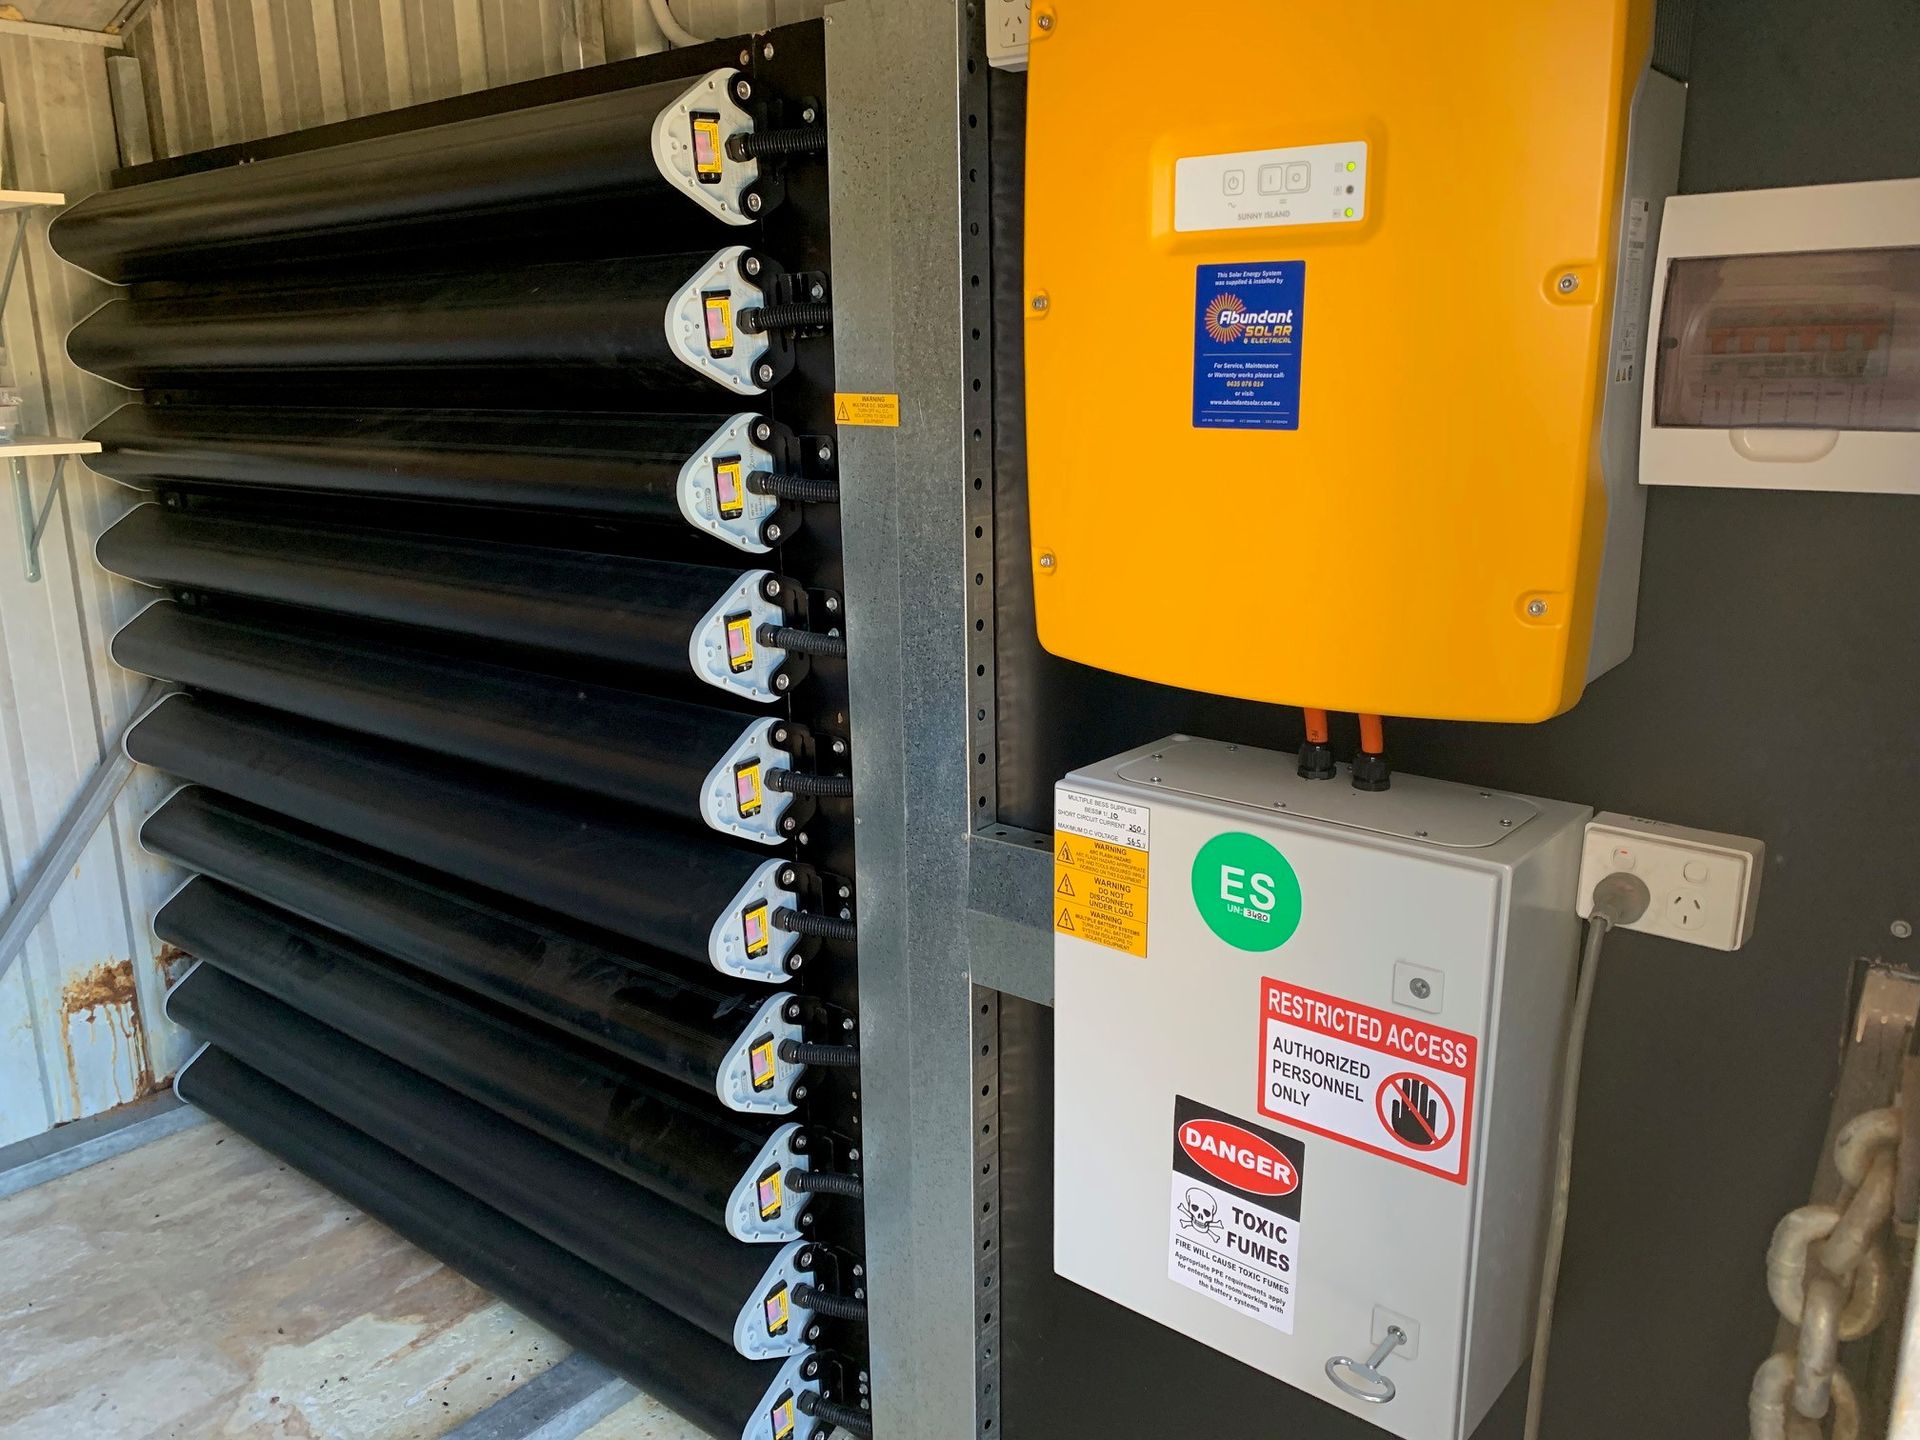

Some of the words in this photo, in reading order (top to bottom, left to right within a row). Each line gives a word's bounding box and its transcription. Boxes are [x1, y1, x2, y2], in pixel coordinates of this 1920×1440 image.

[1237, 213, 1263, 221] SUNNY
[1264, 210, 1291, 219] ISLAND
[1220, 309, 1293, 325] Abundant
[1245, 325, 1293, 337] SOLAR
[1068, 794, 1093, 806] MULTIPLE
[1094, 799, 1110, 809] BESS
[1110, 803, 1137, 815] SUPPLIES
[1057, 809, 1076, 819] SHORT
[1076, 813, 1099, 823] CIRCUIT
[1099, 818, 1126, 830] CURRENT
[1057, 822, 1083, 833] MAXIMUM
[1094, 830, 1119, 842] VOLTAGE
[1094, 842, 1127, 856] WARNING
[1094, 876, 1131, 893] WARNING
[1098, 887, 1108, 896] DO
[1110, 891, 1125, 900] NOT
[1220, 864, 1276, 911] ES
[1089, 892, 1134, 910] DISCONNECT
[1089, 899, 1113, 912] UNDER
[1114, 906, 1134, 918] LOAD
[1090, 910, 1123, 925] WARNING
[1268, 988, 1382, 1043] RESTRICTED
[1386, 1023, 1468, 1069] ACCESS
[1272, 1036, 1370, 1079] AUTHORIZED
[1272, 1059, 1364, 1102] PERSONNEL
[1271, 1082, 1310, 1107] ONLY
[1185, 1127, 1291, 1186] DANGER
[1231, 1206, 1288, 1244] TOXIC
[1226, 1231, 1290, 1272] FUMES
[1175, 1238, 1191, 1251] FIRE
[1193, 1246, 1210, 1260] WILL
[1212, 1254, 1237, 1271] CAUSE
[1239, 1266, 1261, 1282] TOXIC
[1262, 1278, 1289, 1295] FUMES
[1174, 1251, 1210, 1272] Appropriate
[1211, 1267, 1224, 1278] PPE
[1224, 1275, 1267, 1297] requirements
[1268, 1294, 1286, 1307] apply
[1177, 1261, 1186, 1270] for
[1187, 1266, 1213, 1282] entering
[1213, 1277, 1224, 1287] the
[1269, 1303, 1284, 1315] with
[1198, 1280, 1209, 1289] the
[1210, 1285, 1233, 1301] battery
[1234, 1297, 1260, 1312] systems
